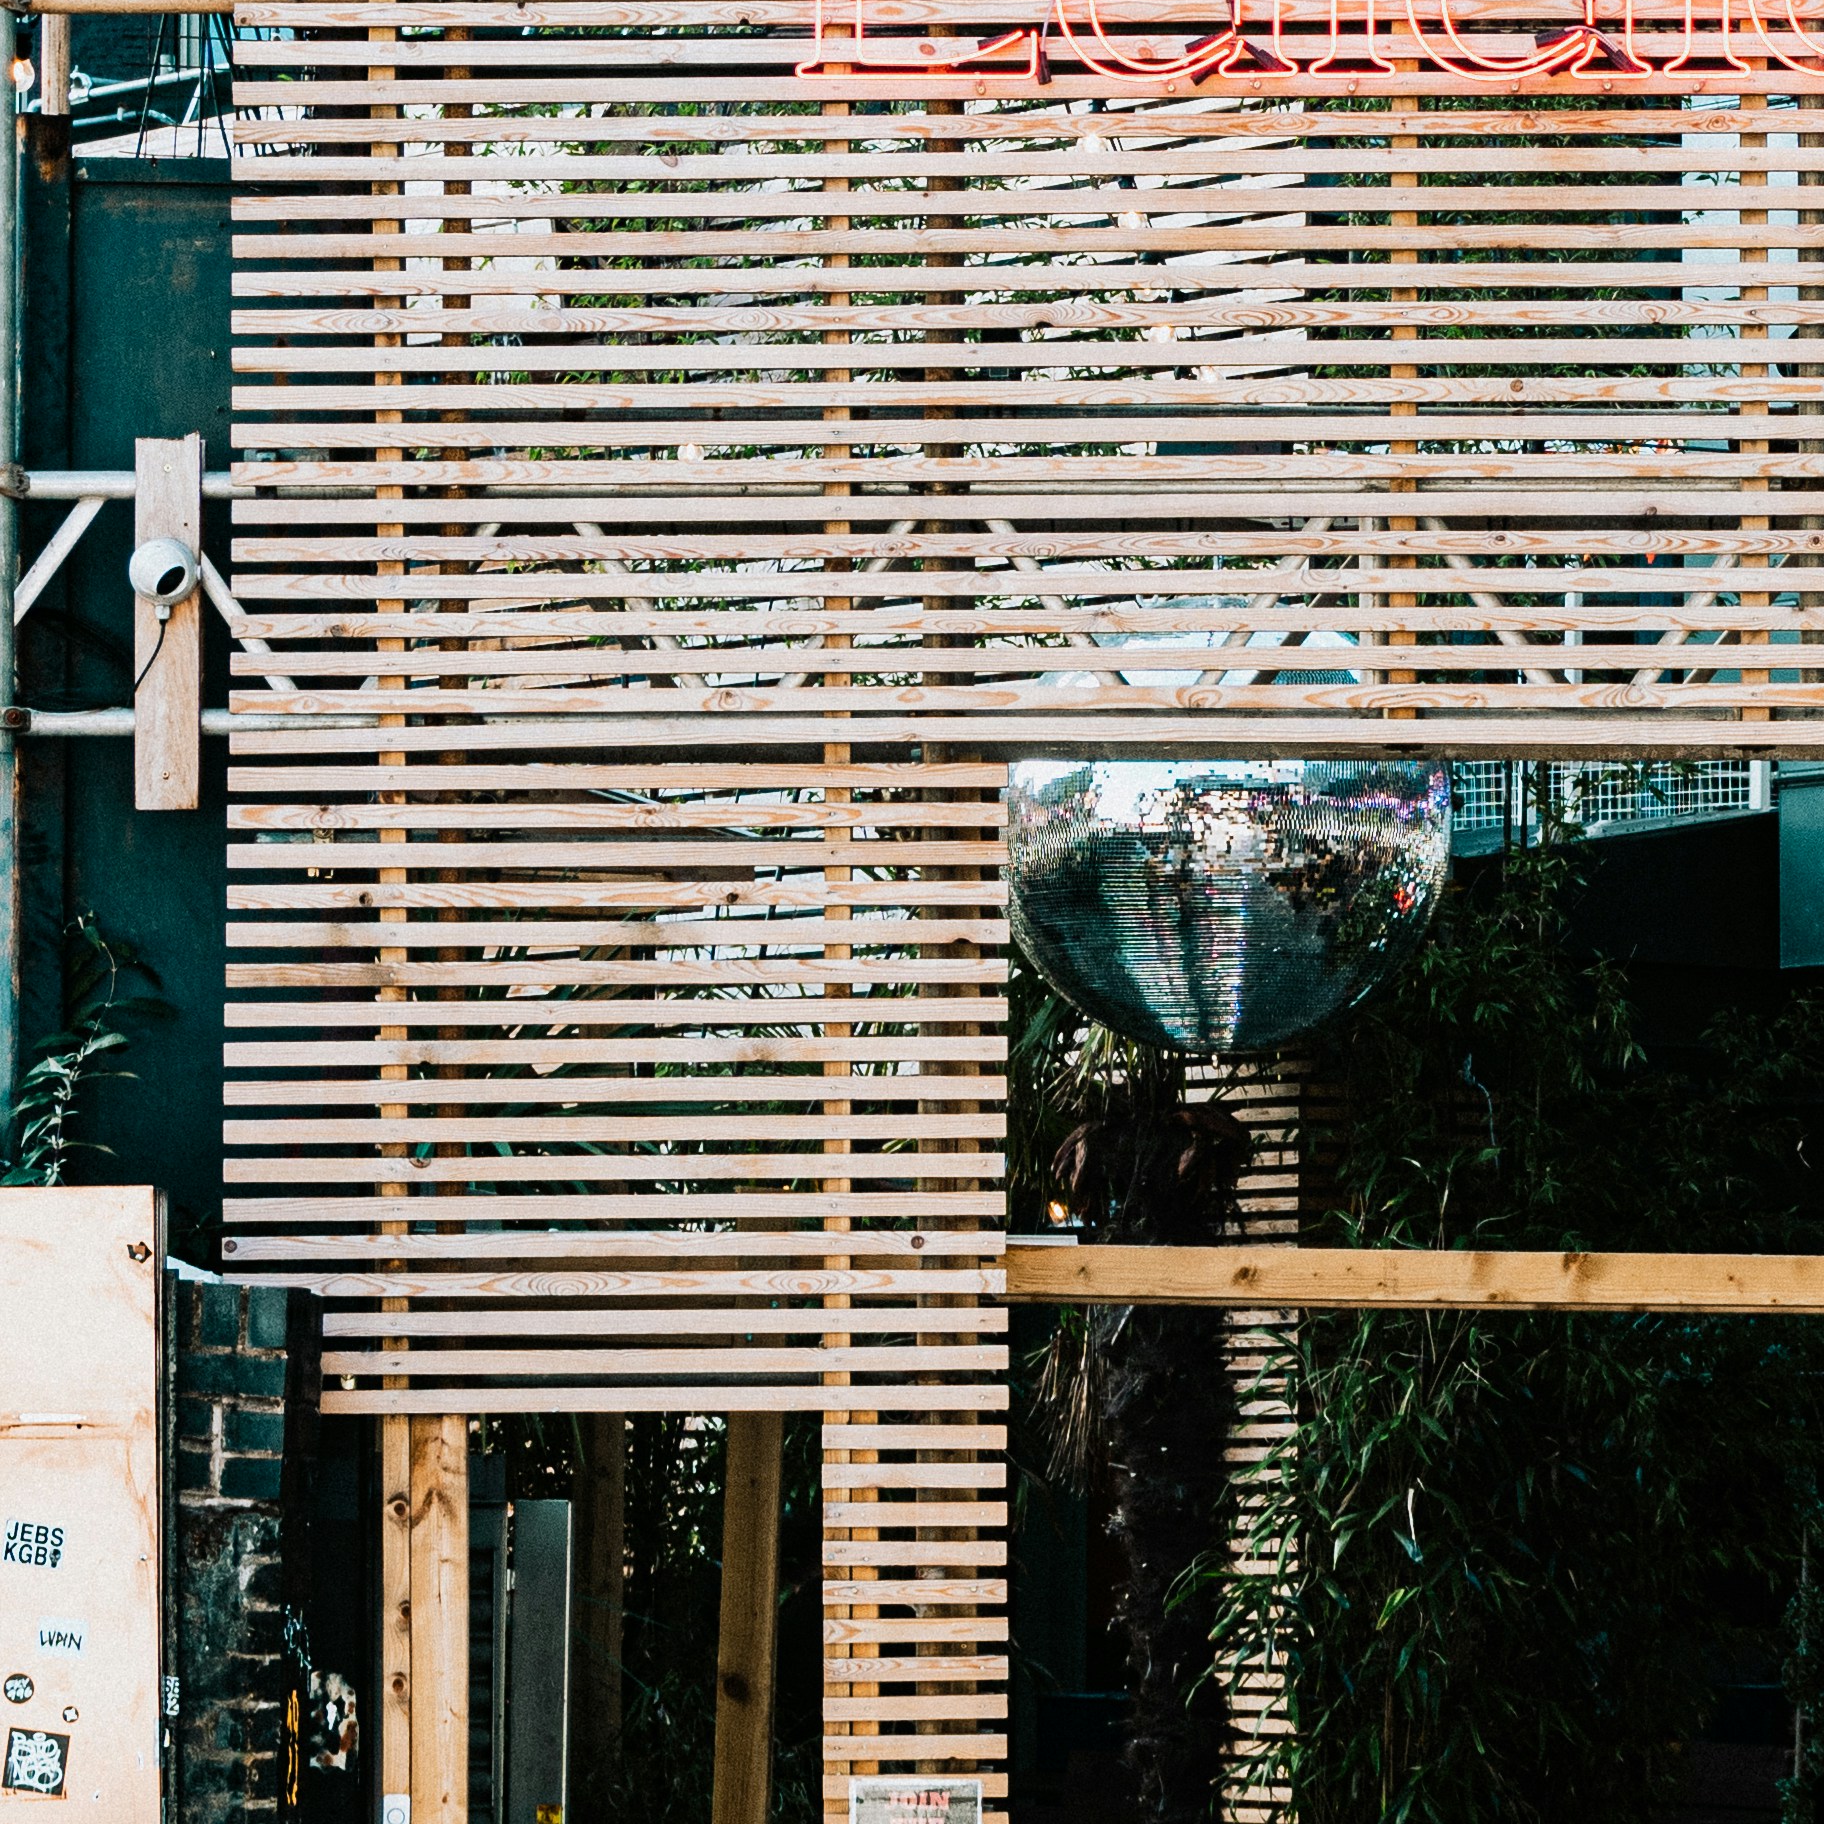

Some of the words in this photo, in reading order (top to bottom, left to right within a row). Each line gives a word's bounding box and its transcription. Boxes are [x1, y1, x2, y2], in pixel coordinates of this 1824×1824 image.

[7, 1521, 64, 1547] JEBS
[4, 1541, 48, 1566] KGB
[885, 1791, 950, 1811] JOIN
